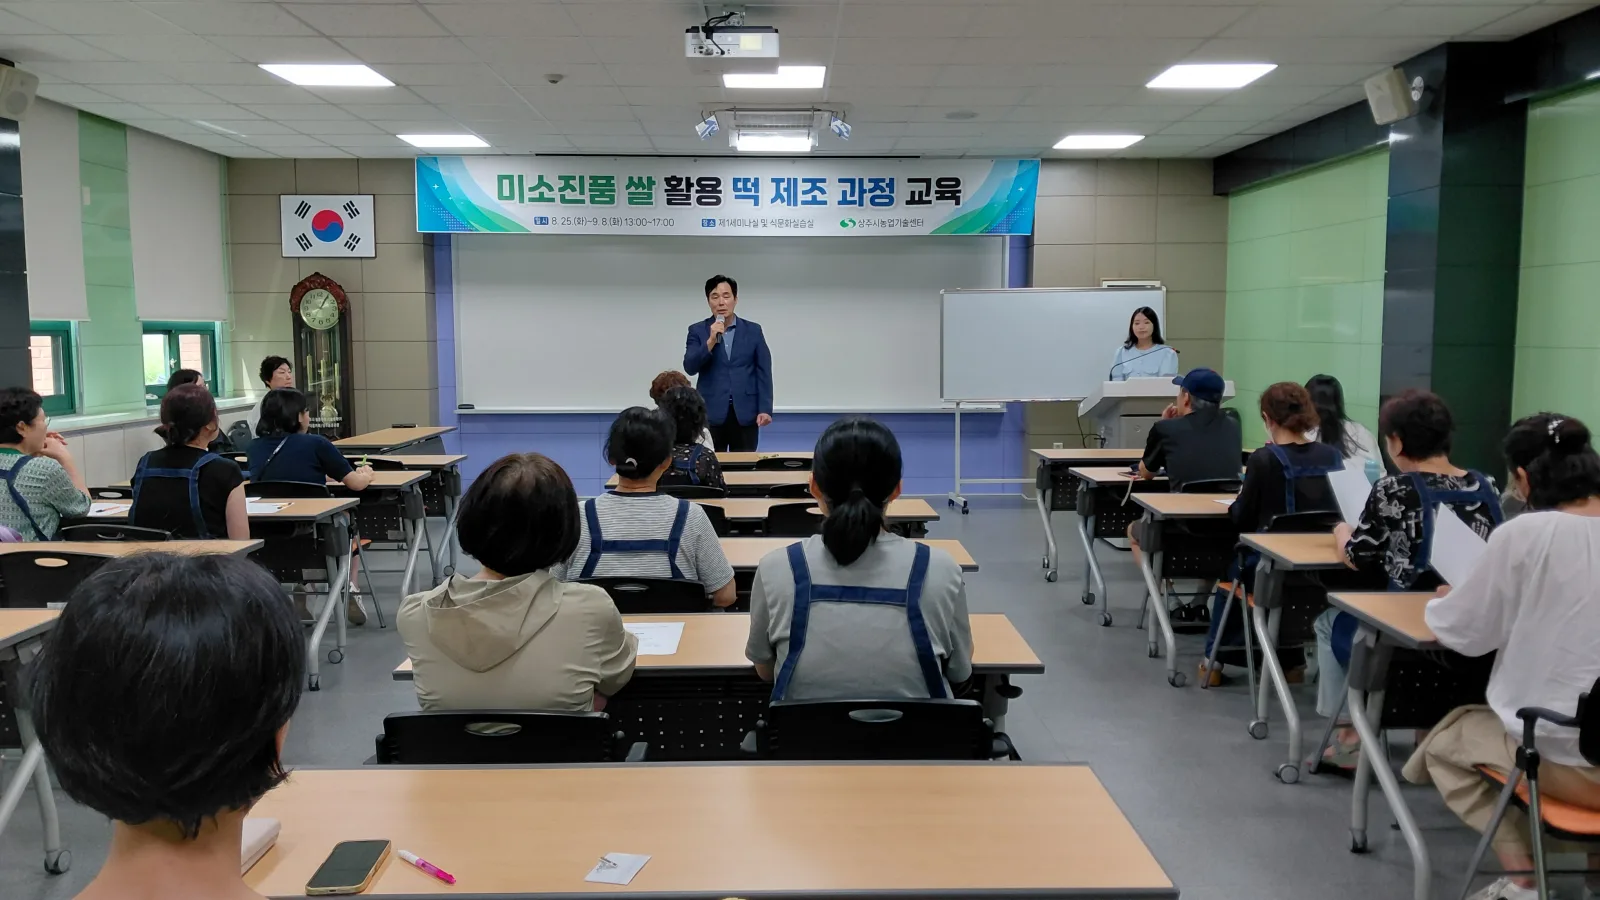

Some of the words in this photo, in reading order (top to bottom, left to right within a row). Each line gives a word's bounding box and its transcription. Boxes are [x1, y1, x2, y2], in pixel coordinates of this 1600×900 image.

[496, 174, 616, 205] 미소진품
[625, 175, 657, 206] 쌀
[663, 175, 723, 207] 활용
[732, 176, 760, 207] 떡
[770, 176, 828, 207] 제조
[837, 176, 896, 208] 과정
[905, 176, 962, 207] 교육
[702, 219, 716, 227] 장소
[718, 218, 759, 228] 제1세미나실
[760, 218, 768, 228] 및
[769, 218, 814, 229] 식문화실습실
[858, 218, 924, 229] 상주시농업기술센터
